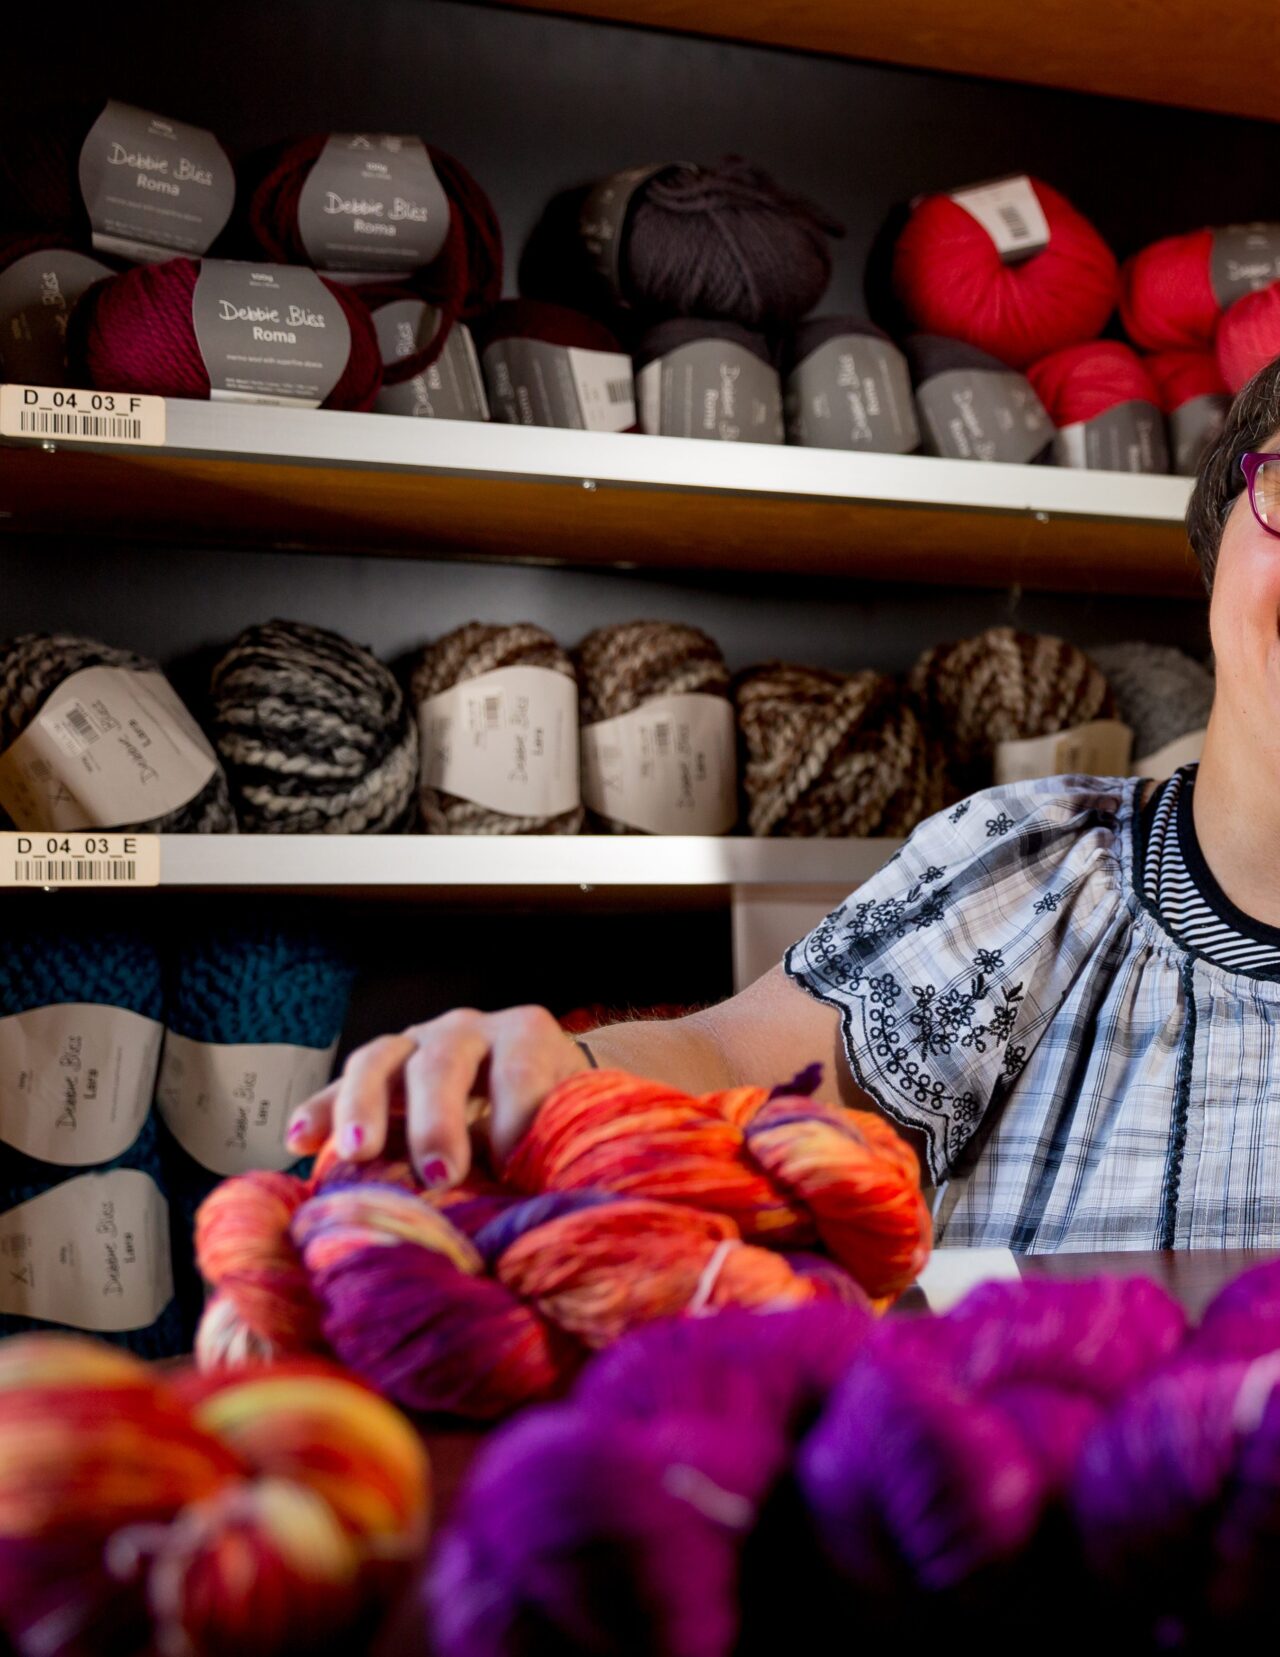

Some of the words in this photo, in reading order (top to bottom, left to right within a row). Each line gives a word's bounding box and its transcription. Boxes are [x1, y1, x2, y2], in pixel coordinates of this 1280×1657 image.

[107, 142, 169, 174] Debbie
[173, 157, 213, 186] Bliss
[136, 173, 180, 196] Roma
[323, 191, 384, 217] Debbie
[388, 197, 428, 222] Bliss
[353, 218, 397, 236] Roma
[218, 299, 280, 323] Debbie
[285, 305, 326, 328] Bliss
[253, 326, 297, 344] Roma
[24, 389, 142, 416] D_04_03_F
[17, 837, 137, 858] D_04_03_E
